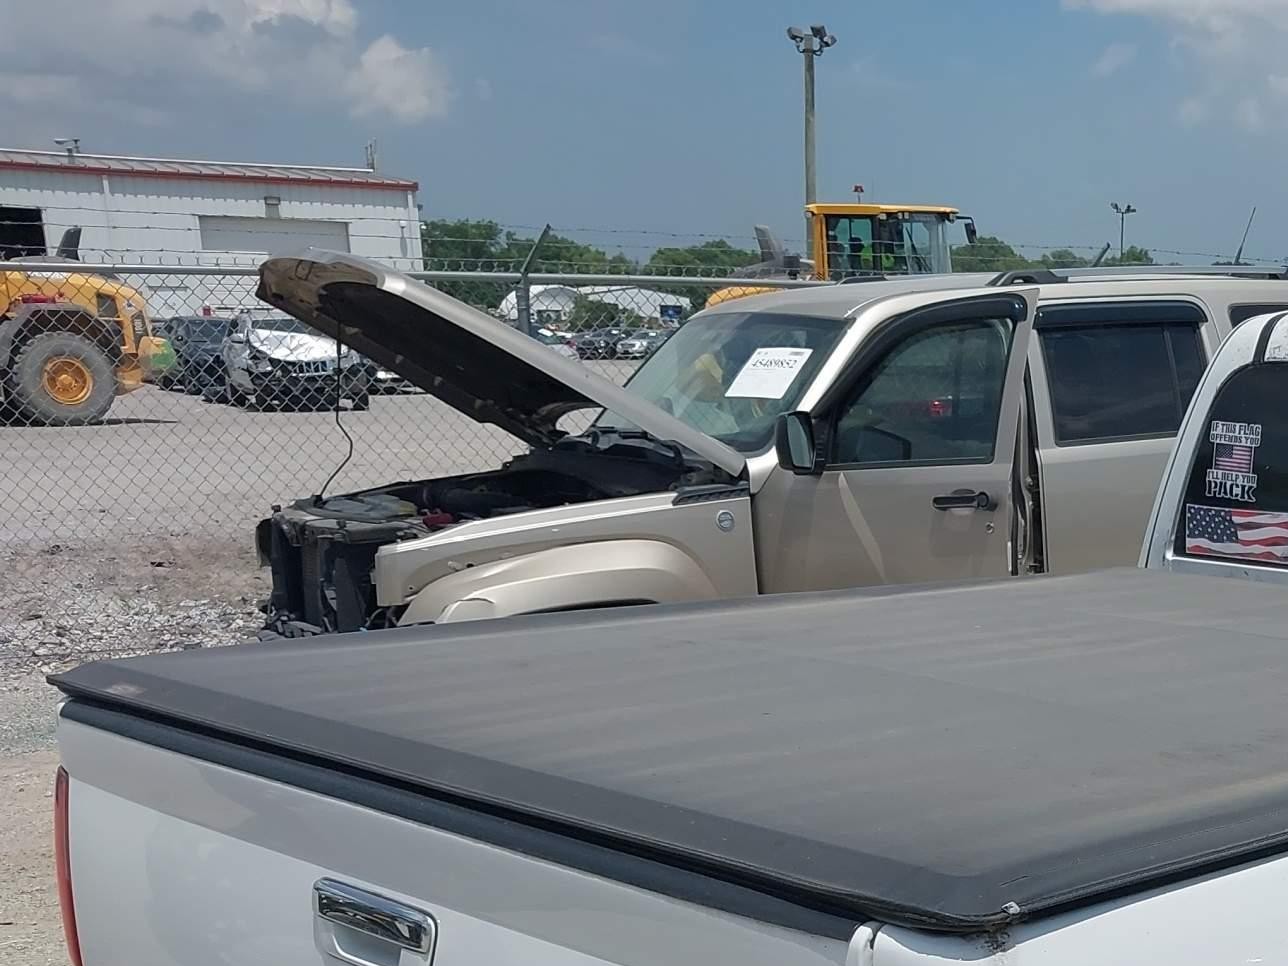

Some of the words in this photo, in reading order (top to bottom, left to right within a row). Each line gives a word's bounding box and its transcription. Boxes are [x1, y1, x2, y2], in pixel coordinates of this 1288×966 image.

[1212, 422, 1220, 433] IF
[1221, 423, 1237, 434] THIS
[1238, 424, 1261, 437] FLAG
[1210, 433, 1243, 444] OFFENDS
[1244, 436, 1260, 446] YOU
[1221, 472, 1241, 482] HELP
[1241, 474, 1256, 485] YOU
[1206, 480, 1256, 501] PACK
